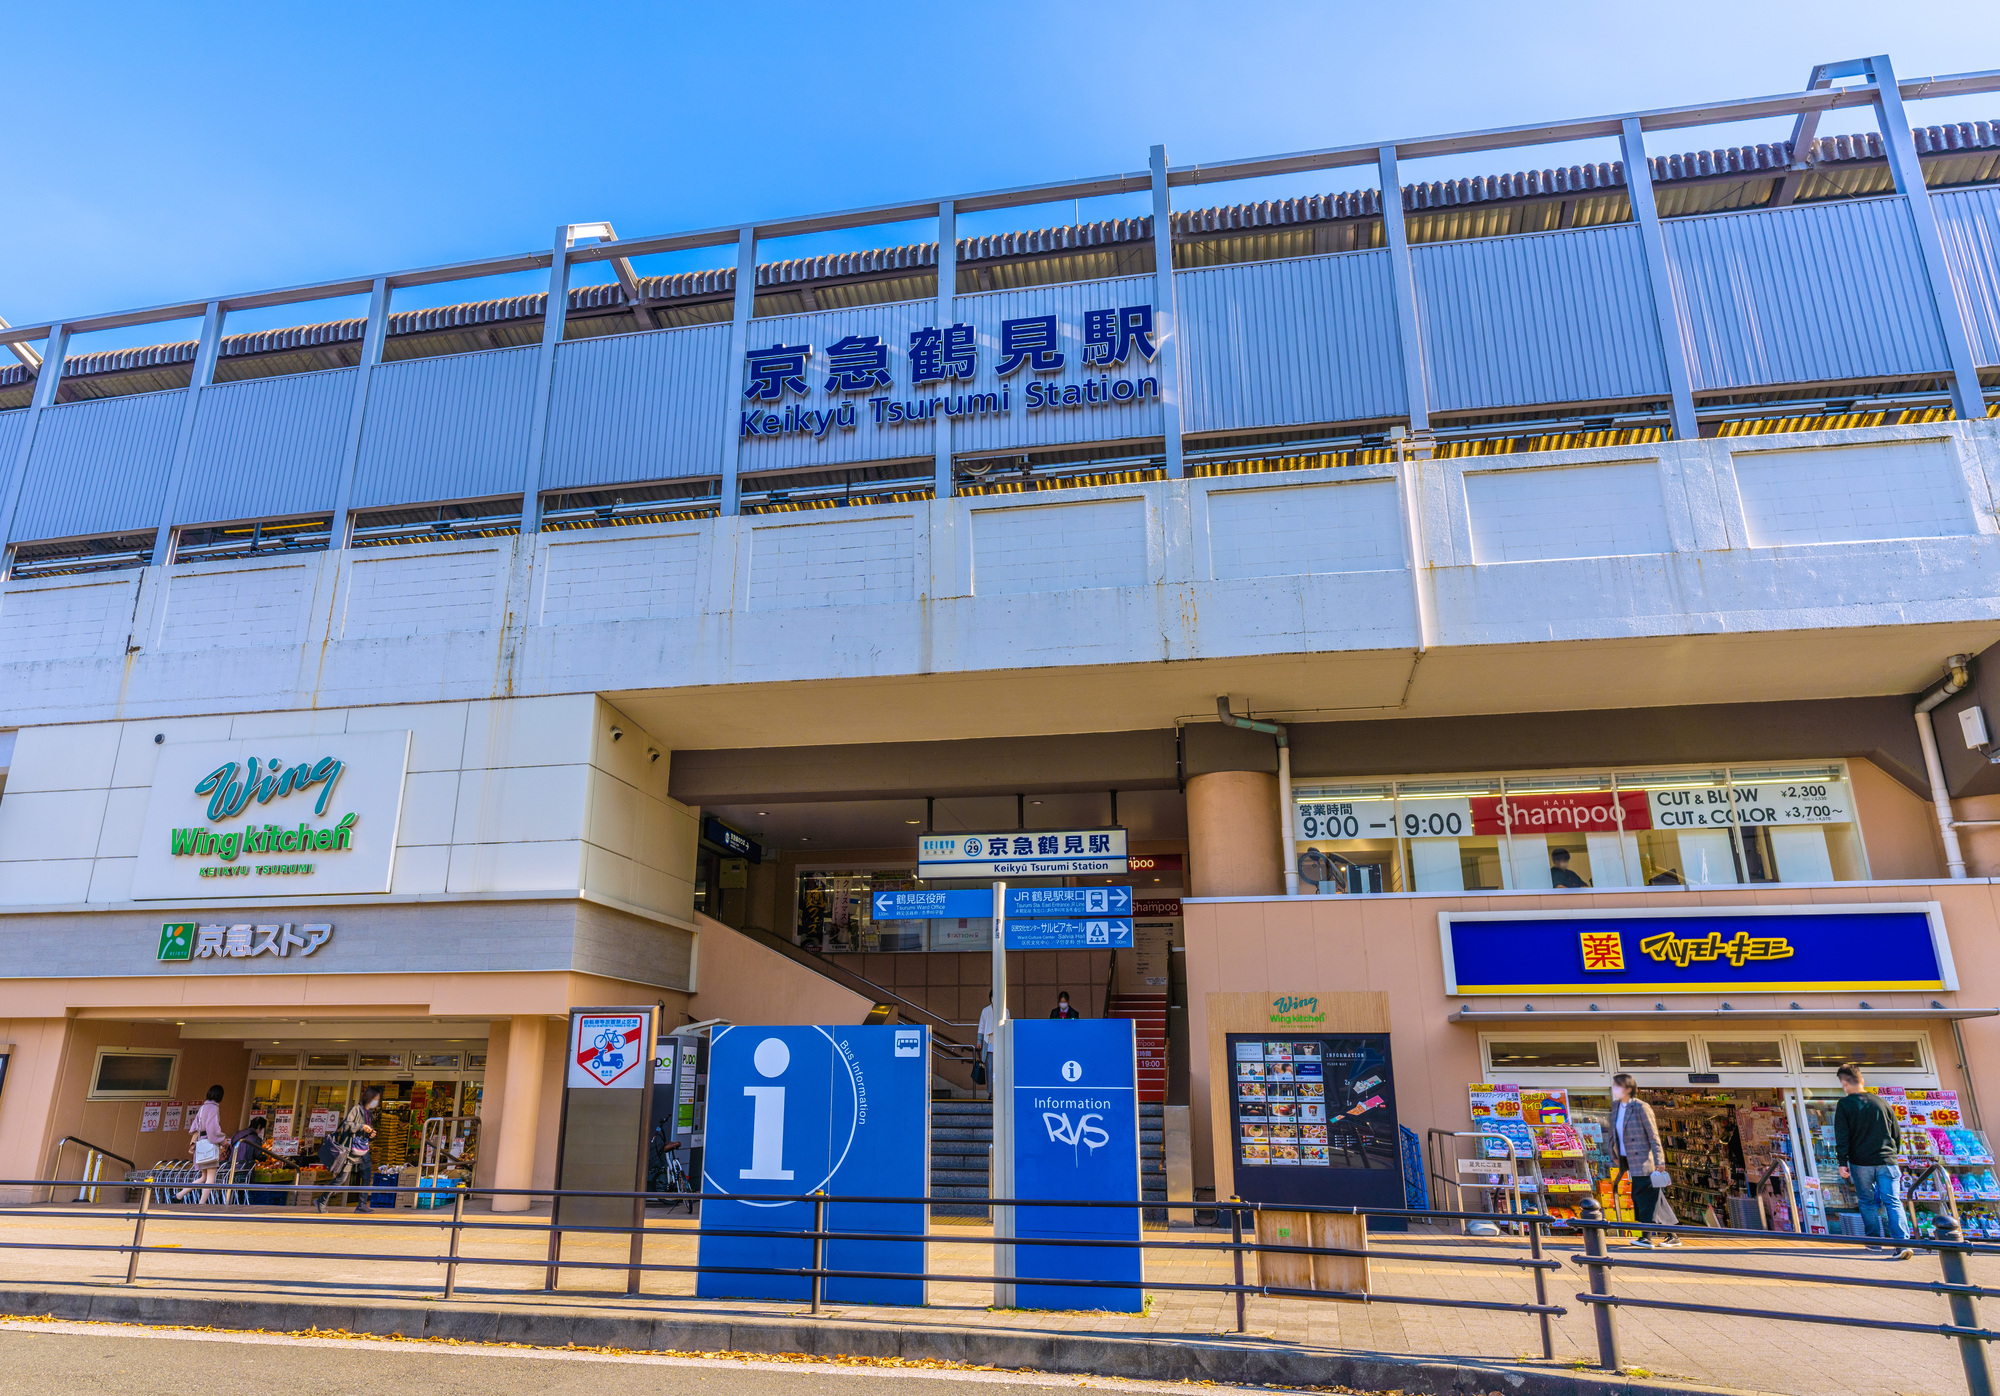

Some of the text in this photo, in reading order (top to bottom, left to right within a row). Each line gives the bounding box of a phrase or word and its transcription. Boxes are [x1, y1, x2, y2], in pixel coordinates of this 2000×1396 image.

[743, 304, 1158, 400] 京急鶴見駅
[740, 376, 1160, 439] Keikyū Tsurumi Station
[195, 756, 346, 822] Wing
[1657, 785, 1826, 806] CUT & BLOW ¥2,300
[1300, 803, 1353, 816] 営業時間
[1495, 802, 1626, 829] Shampoo
[1660, 811, 1694, 826] CUT
[1698, 814, 1708, 825] &
[1710, 807, 1777, 823] COLOR
[1303, 816, 1358, 838] 9:00
[1389, 812, 1462, 836] 19:00
[171, 814, 358, 861] Wing kitchen
[924, 840, 955, 850] KEIKYU
[967, 845, 979, 854] 29
[988, 834, 1111, 857] 京急鶴見駅
[199, 863, 315, 877] KEIKYU TSURUMI
[994, 861, 1109, 875] Keikyū Tsurumi Station
[896, 892, 946, 905] 鶴見区役所
[1014, 890, 1085, 902] JR 鶴見駅東口
[1132, 901, 1178, 913] Shampoo
[1041, 922, 1085, 933] サルビアホール
[194, 922, 334, 958] 京急ストア
[1583, 933, 1622, 968] 薬
[1640, 931, 1794, 967] マツモトキヨシ
[1273, 996, 1318, 1014] Wing
[1270, 1012, 1325, 1024] Wing kitchen
[683, 1053, 696, 1065] PUDO
[1141, 1060, 1160, 1068] 19:00
[840, 1040, 868, 1125] Bus Information
[1873, 1087, 1891, 1095] SALE
[1920, 1092, 1940, 1100] SALE
[1034, 1096, 1111, 1109] Information
[1497, 1102, 1520, 1111] 980
[1932, 1110, 1960, 1120] 168
[1043, 1112, 1109, 1150] RVS
